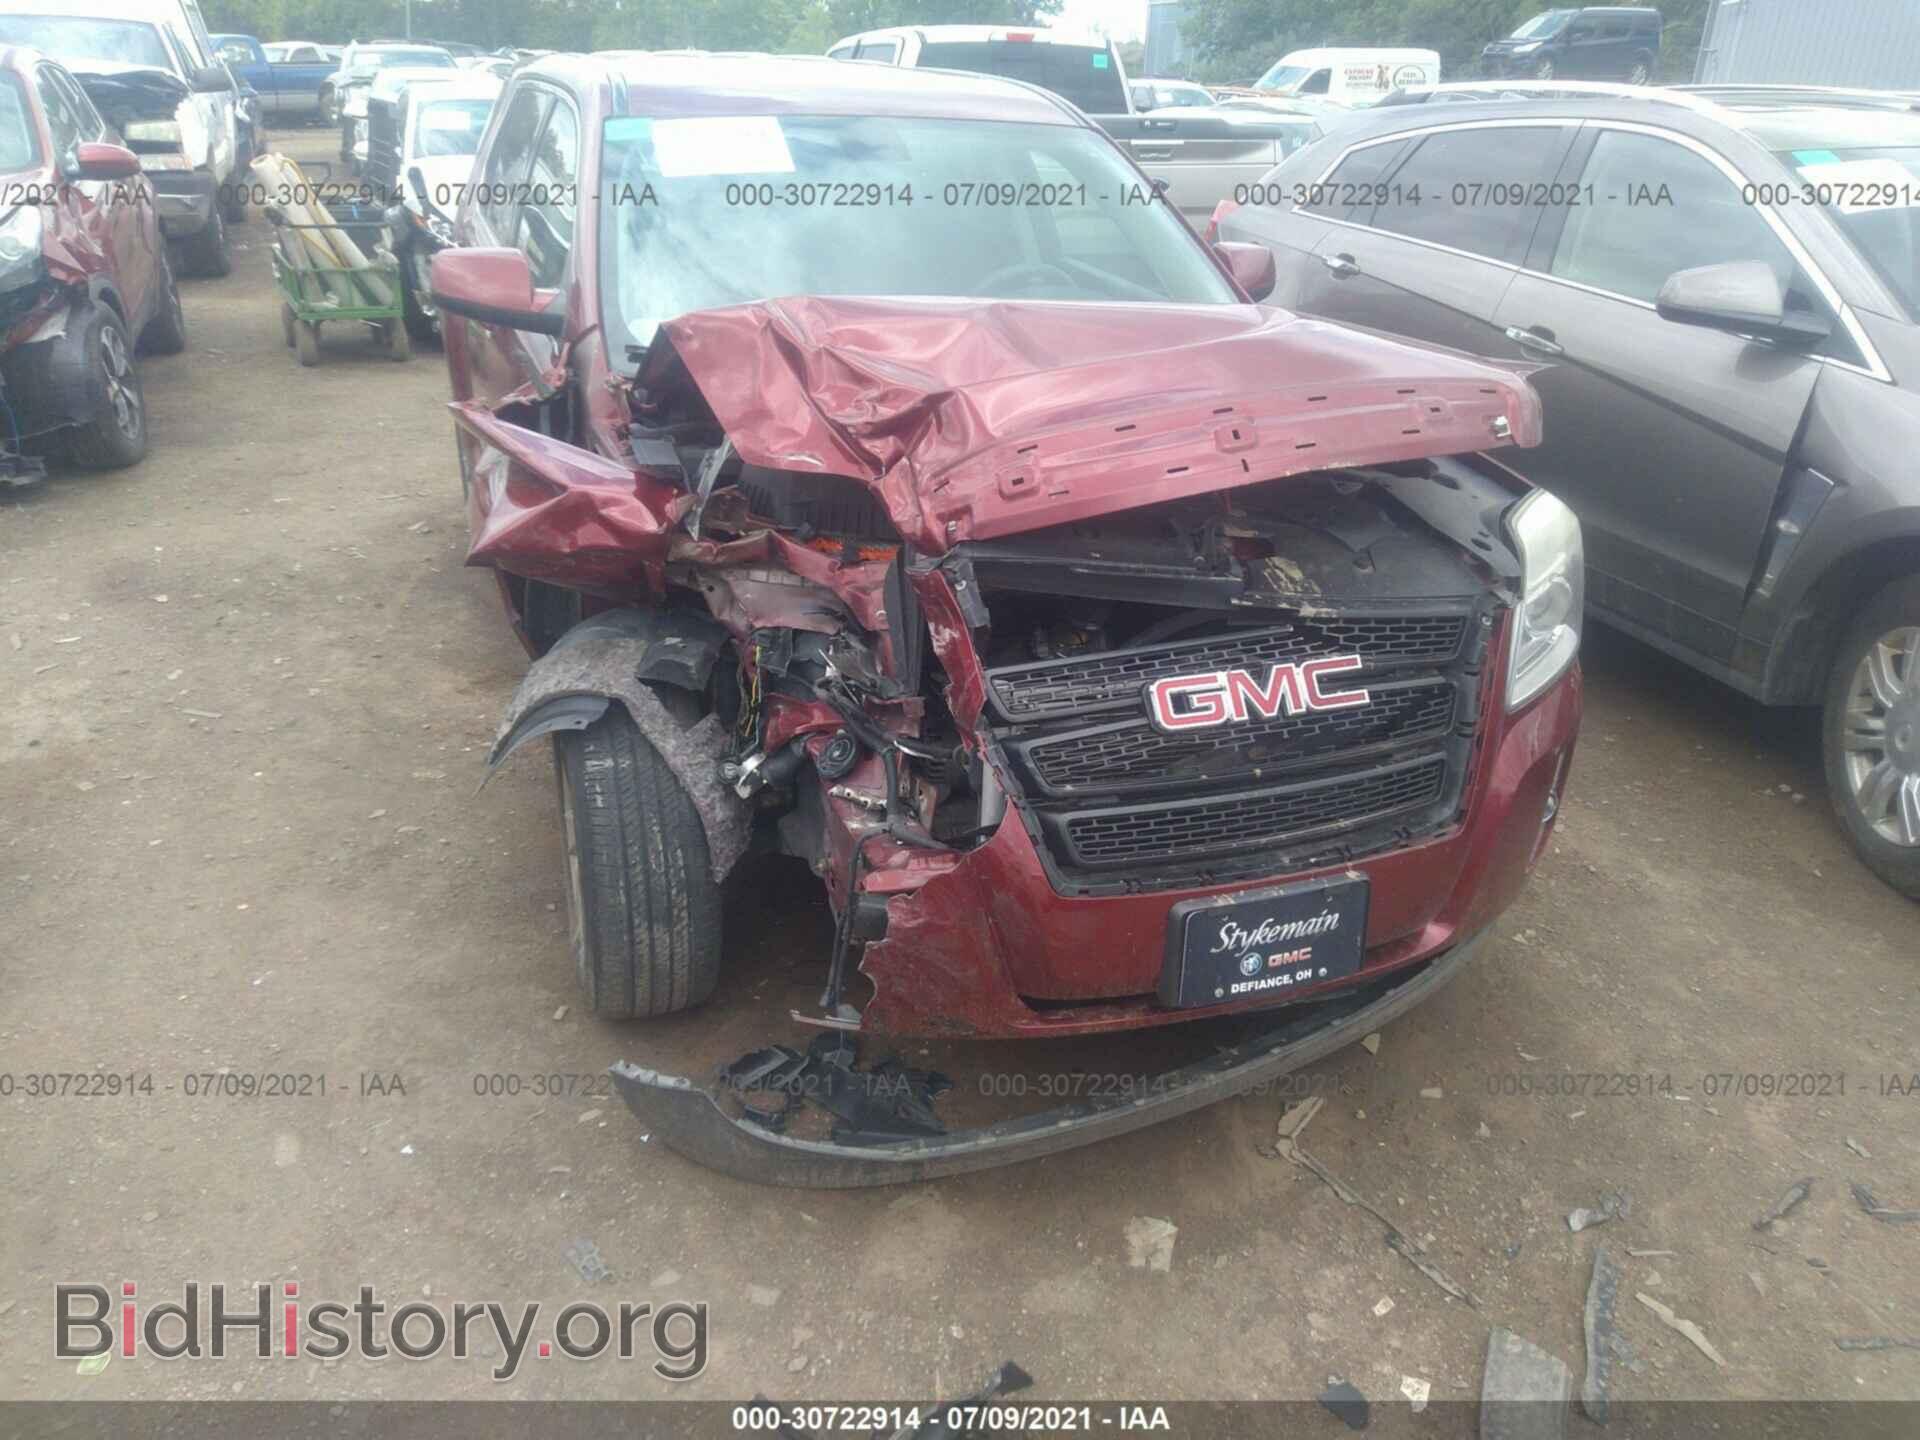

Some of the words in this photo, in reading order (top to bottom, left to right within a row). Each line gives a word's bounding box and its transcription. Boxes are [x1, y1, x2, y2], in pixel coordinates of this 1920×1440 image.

[1149, 655, 1370, 730] GMC
[1210, 909, 1340, 957] Stykemain
[1268, 946, 1312, 968] GMC
[1231, 974, 1293, 994] DEFIANCE,
[1296, 968, 1312, 982] OH
